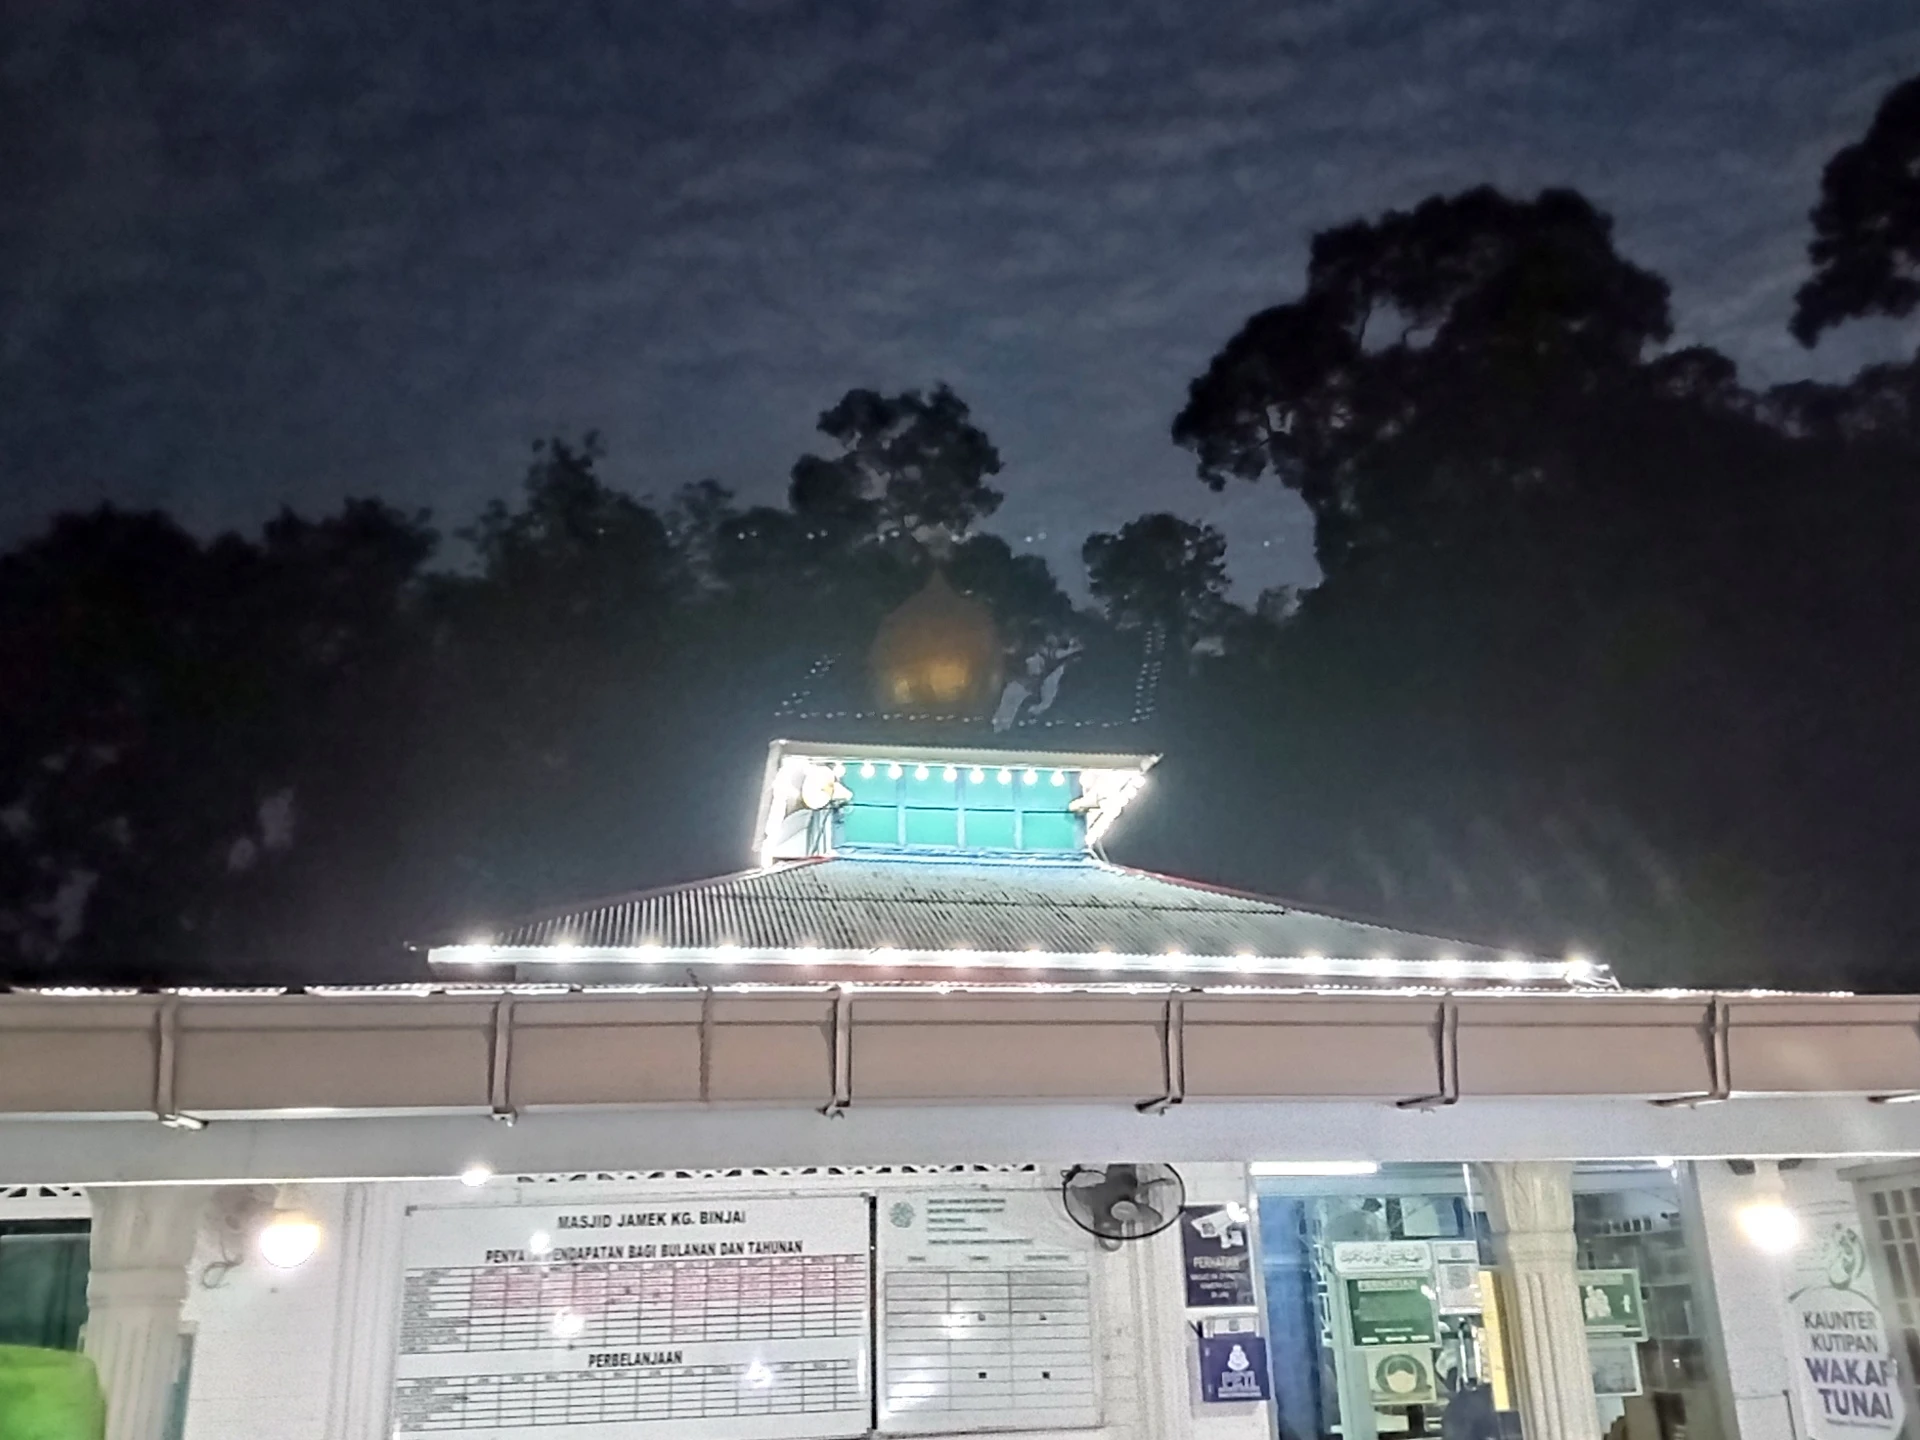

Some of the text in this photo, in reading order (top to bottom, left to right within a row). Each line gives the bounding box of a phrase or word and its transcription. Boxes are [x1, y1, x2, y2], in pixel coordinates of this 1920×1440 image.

[557, 1210, 746, 1230] MASJID JAMEK KG. BINJAI
[485, 1239, 803, 1264] PENYA ENDAPATAN BAGI BULANAN DAN TAHUNAN
[1803, 1311, 1878, 1330] KAUNTER
[1811, 1333, 1878, 1353] KUTIPAN
[588, 1350, 683, 1368] PERBELANJAAN
[1818, 1388, 1894, 1420] TUNAI
